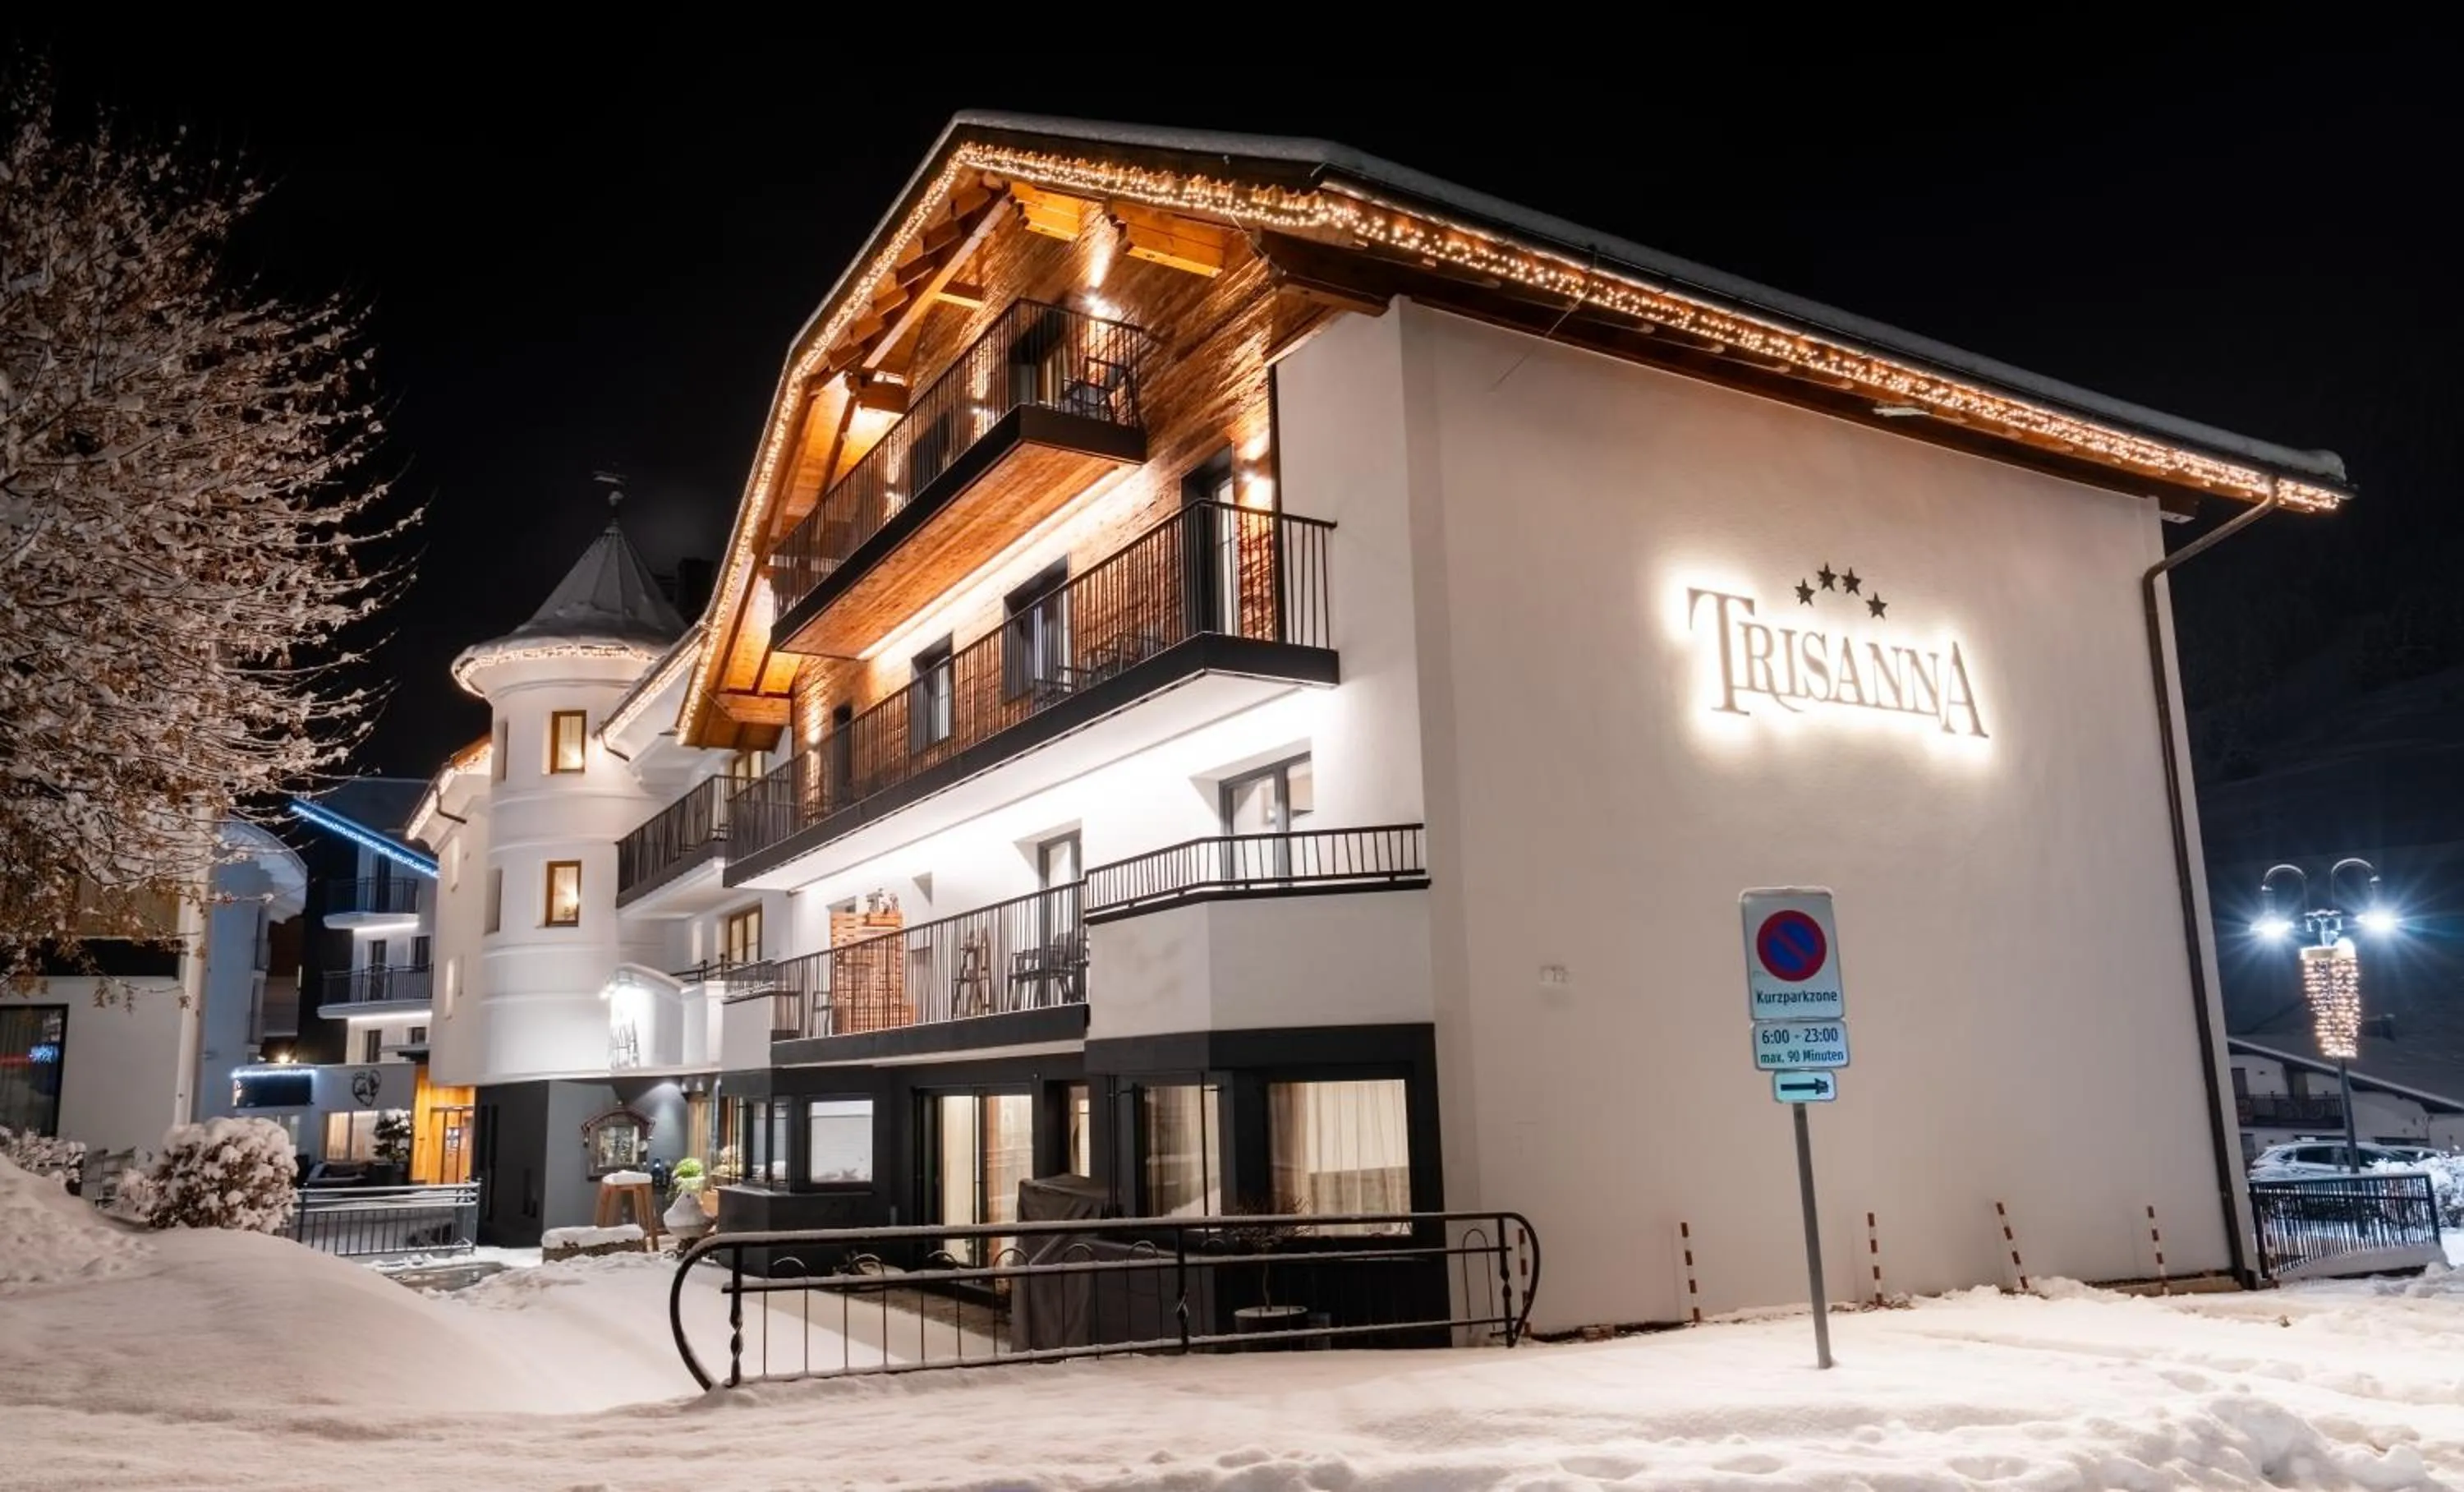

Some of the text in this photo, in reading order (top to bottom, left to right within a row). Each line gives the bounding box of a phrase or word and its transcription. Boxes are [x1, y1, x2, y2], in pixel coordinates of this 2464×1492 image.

[1687, 587, 1989, 739] TRISANNA
[1757, 990, 1837, 1006] Kurzparkzone
[1762, 1029, 1790, 1044] 6:00
[1804, 1028, 1839, 1043] 23:00
[1760, 1048, 1844, 1063] max. 90 Minuten
